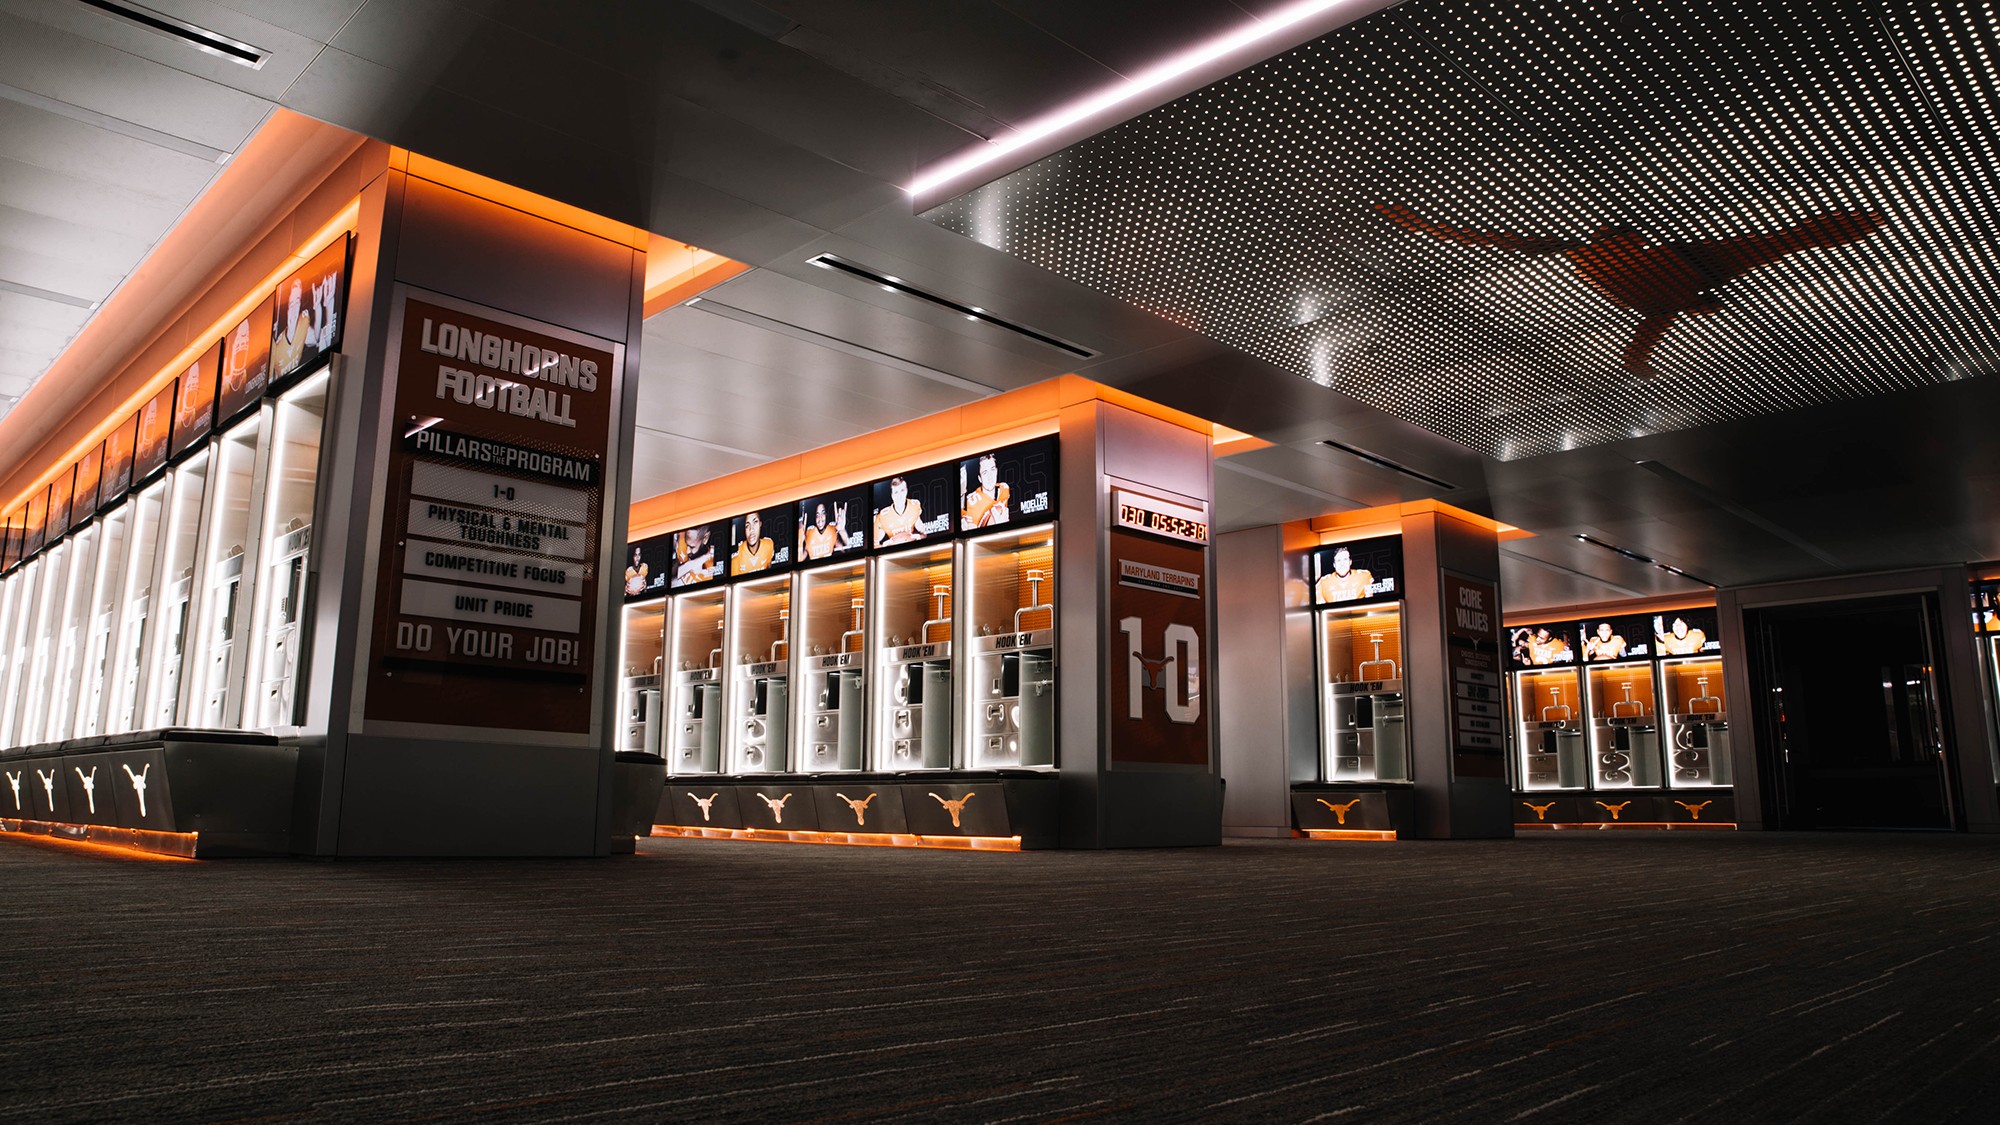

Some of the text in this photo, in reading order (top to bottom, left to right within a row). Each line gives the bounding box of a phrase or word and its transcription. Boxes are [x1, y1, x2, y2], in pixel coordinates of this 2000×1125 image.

[421, 318, 598, 392] LONGHORNS
[436, 365, 576, 428] FOOTBALL
[416, 430, 590, 482] PILLARS OF THE PROGRAM
[493, 484, 515, 500] 1-0
[428, 505, 496, 528] PHYSICAL
[518, 519, 569, 540] MENTAL
[460, 525, 540, 550] TOUGHNESS
[425, 552, 566, 584] COMPETITIVE FOCUS
[1124, 565, 1160, 581] MARYLAND
[1162, 572, 1195, 587] TERRAPINS
[455, 595, 533, 618] UNIT PRIDE
[1459, 586, 1483, 610] CORE
[1455, 608, 1488, 632] VALUES
[396, 622, 579, 666] DO YOUR JOB!
[902, 647, 921, 659] HOOK
[995, 634, 1032, 649] HOOK 'EM
[822, 656, 838, 667] HOOK
[1350, 683, 1369, 692] HOOK
